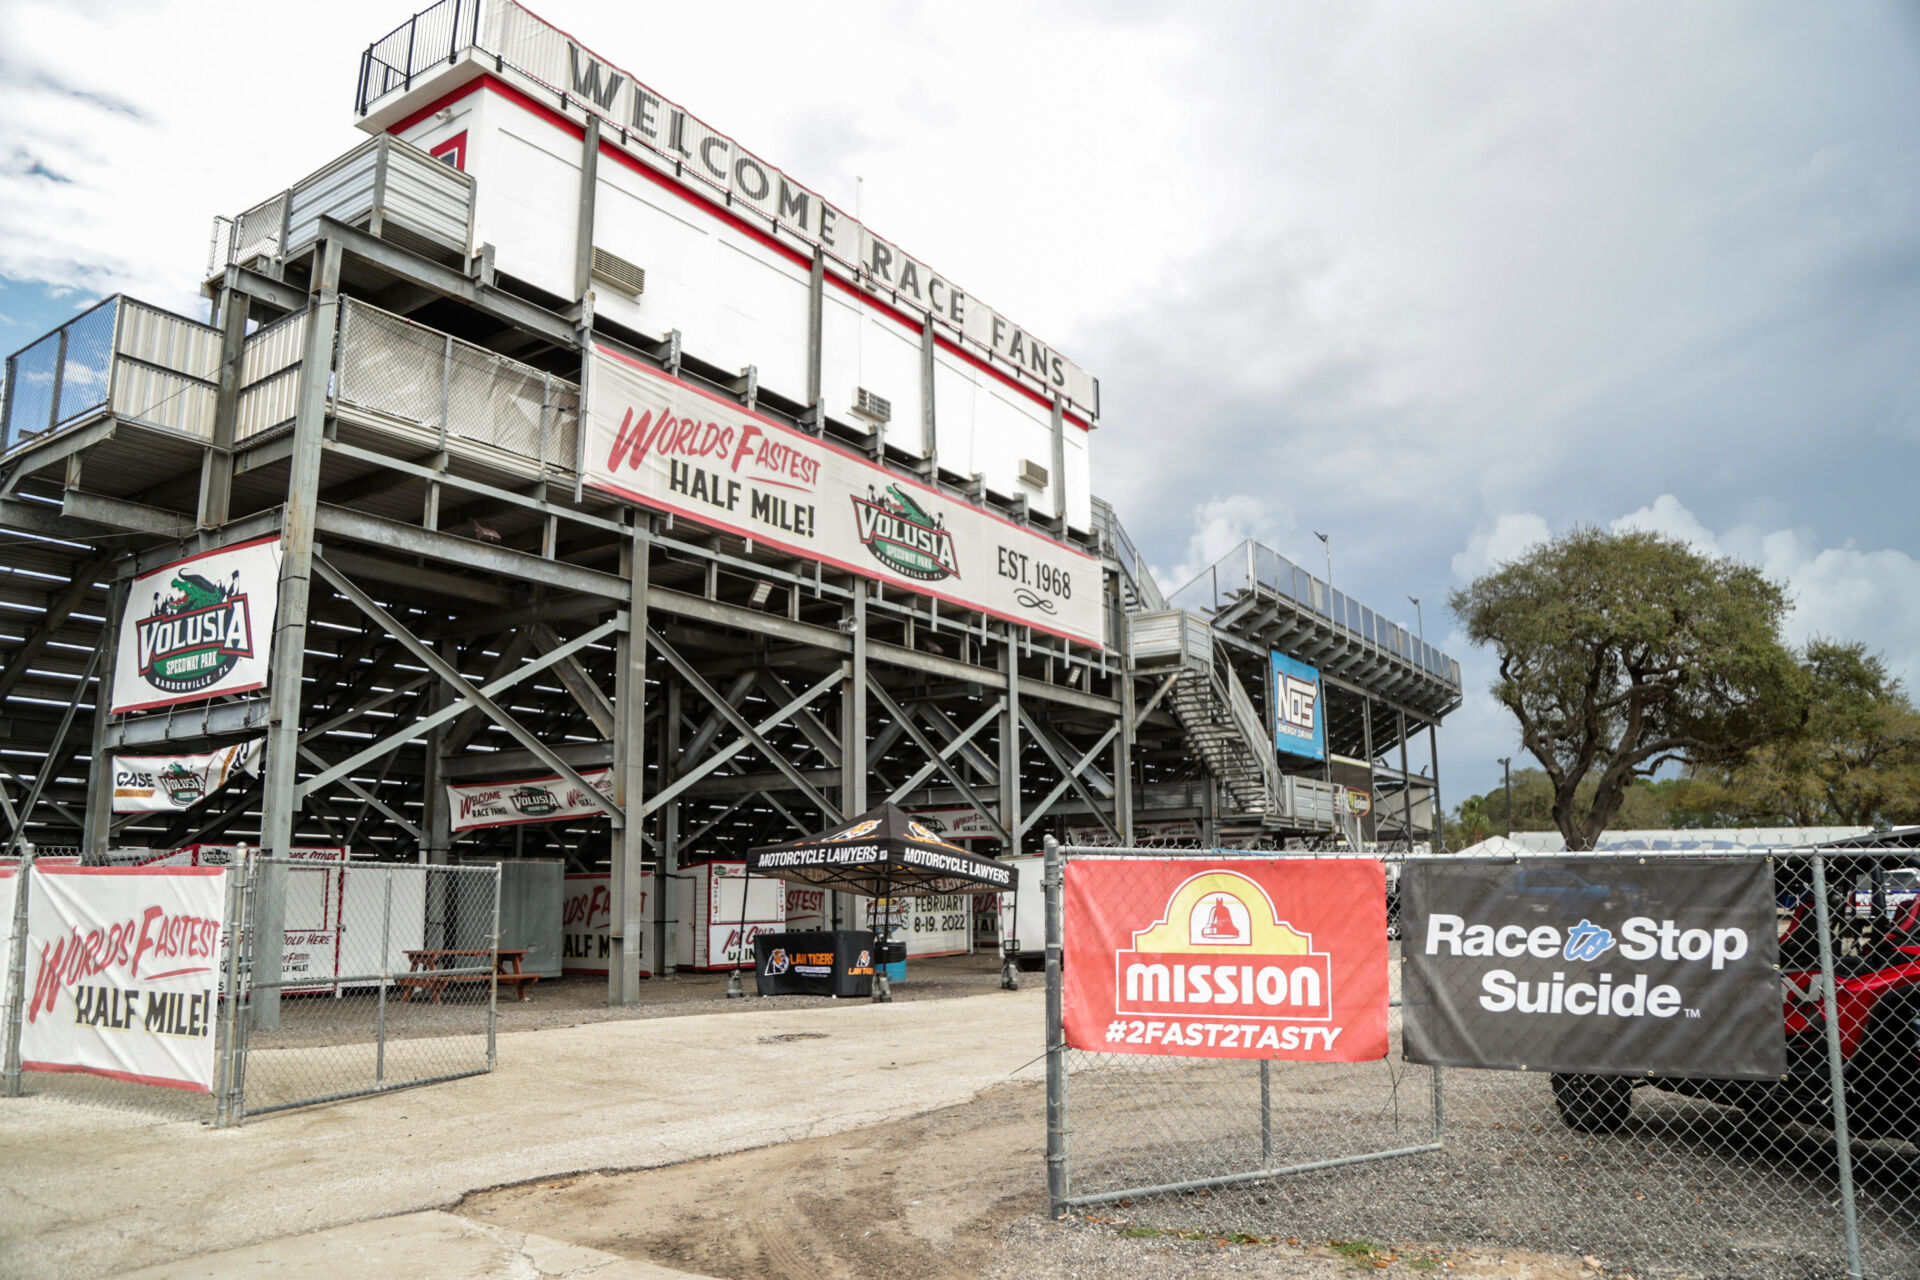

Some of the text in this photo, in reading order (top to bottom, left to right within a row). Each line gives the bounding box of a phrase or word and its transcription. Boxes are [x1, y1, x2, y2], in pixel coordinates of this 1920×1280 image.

[568, 41, 1065, 386] WELCOME RACE FANS
[607, 406, 821, 485] WORLDS FASTEST
[669, 458, 815, 538] HALF MILE!
[856, 500, 956, 571] VOLUSIA
[886, 544, 933, 570] SPEEDWAY PARK
[997, 545, 1072, 600] EST. 1968
[140, 600, 249, 669] VOLUSIA
[166, 650, 218, 675] SPEEDWAY PARK
[155, 665, 229, 690] BARBERVILLE FL
[1277, 671, 1319, 730] NOS
[117, 772, 156, 788] CASE
[162, 776, 205, 792] VOLUSIA
[460, 790, 502, 819] WELCOME
[472, 808, 489, 818] RACE
[512, 795, 558, 810] VOLUSIA
[758, 849, 825, 868] MOTORCYCLE
[827, 845, 878, 863] LAWYERS
[903, 847, 968, 873] MOTORCYCLE
[969, 862, 1011, 884] LAWYERS
[786, 889, 825, 912] STEST
[915, 895, 964, 912] FEBRUARY
[942, 914, 965, 931] 2022
[307, 932, 332, 945] HERE
[563, 933, 593, 958] ALF
[1425, 913, 1749, 970] Race to Stop
[29, 905, 221, 1024] WORLDS FASTEST
[808, 952, 834, 966] TIGERS
[1479, 969, 1682, 1018] Suicide
[75, 985, 212, 1037] HALF MILE!
[1105, 1020, 1343, 1050] #2FAST2TASTY
